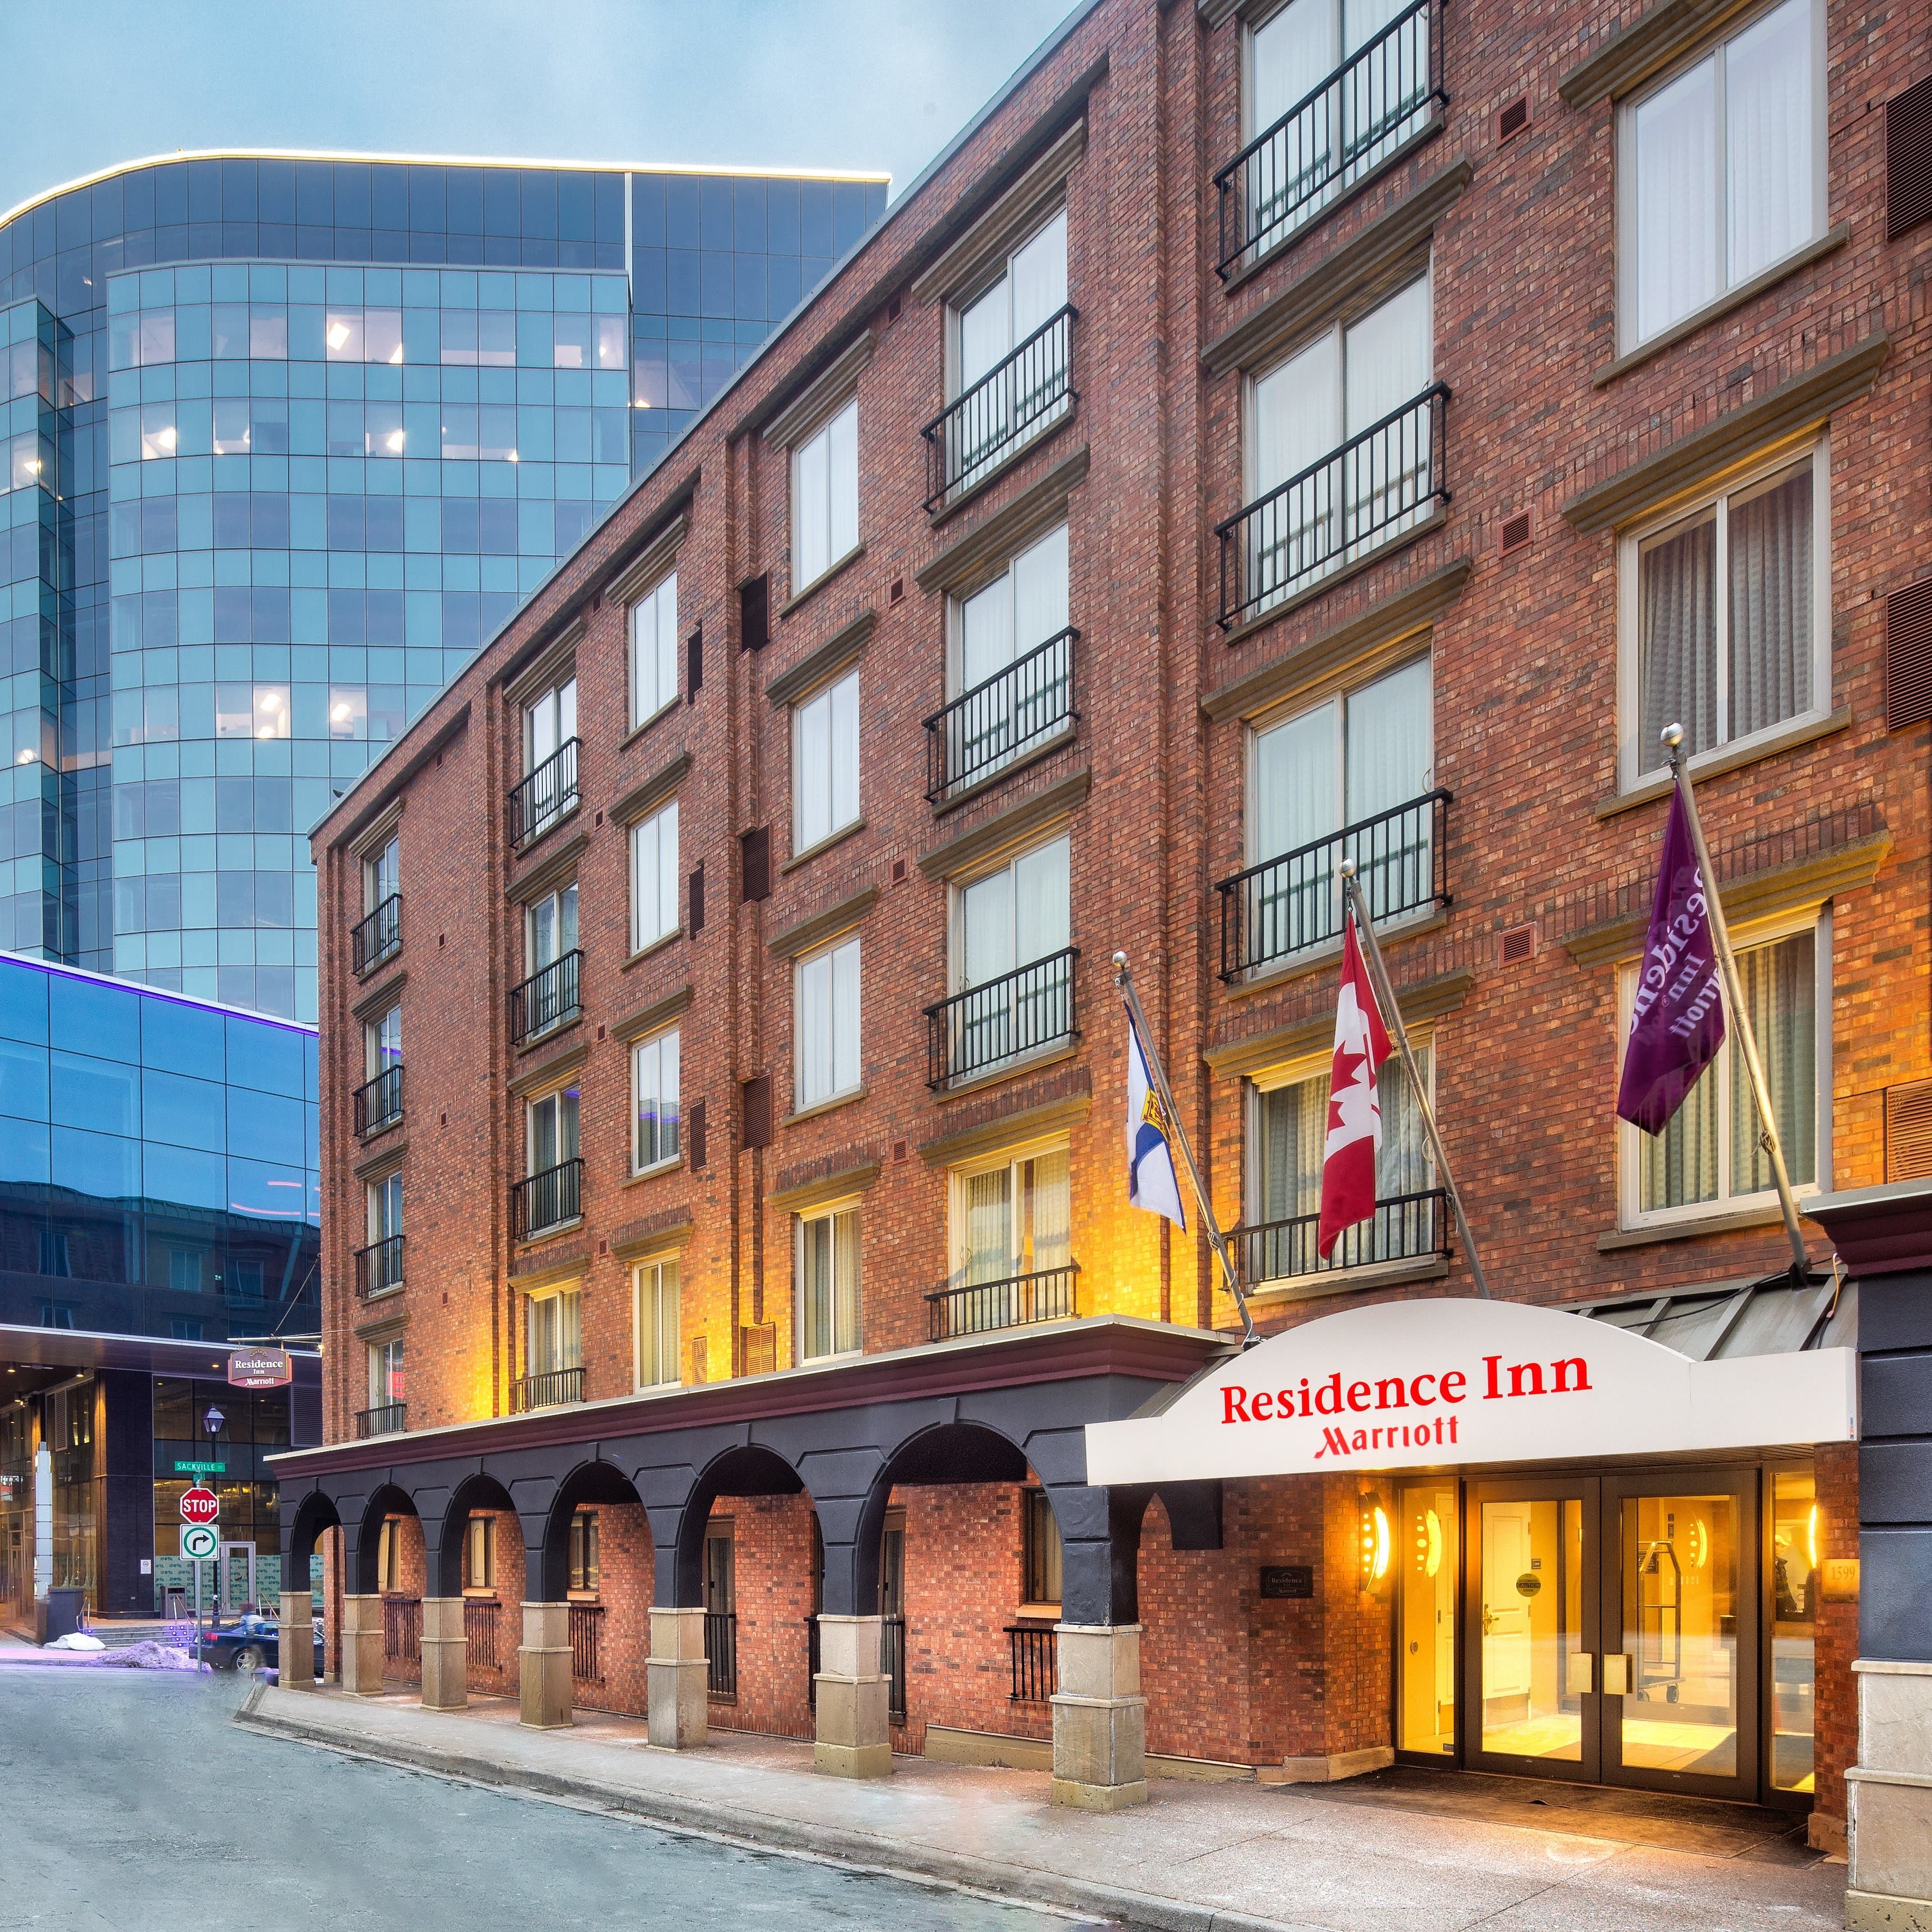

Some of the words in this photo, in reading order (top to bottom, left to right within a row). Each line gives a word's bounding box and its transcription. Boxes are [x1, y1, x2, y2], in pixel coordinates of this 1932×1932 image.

[235, 1359, 283, 1368] Residence
[244, 1378, 274, 1387] Marriott
[1220, 1372, 1466, 1424] Residence
[1482, 1355, 1593, 1400] Inn
[1313, 1415, 1460, 1460] Marriott
[183, 1499, 217, 1513] STOP
[1831, 1566, 1855, 1580] 1599
